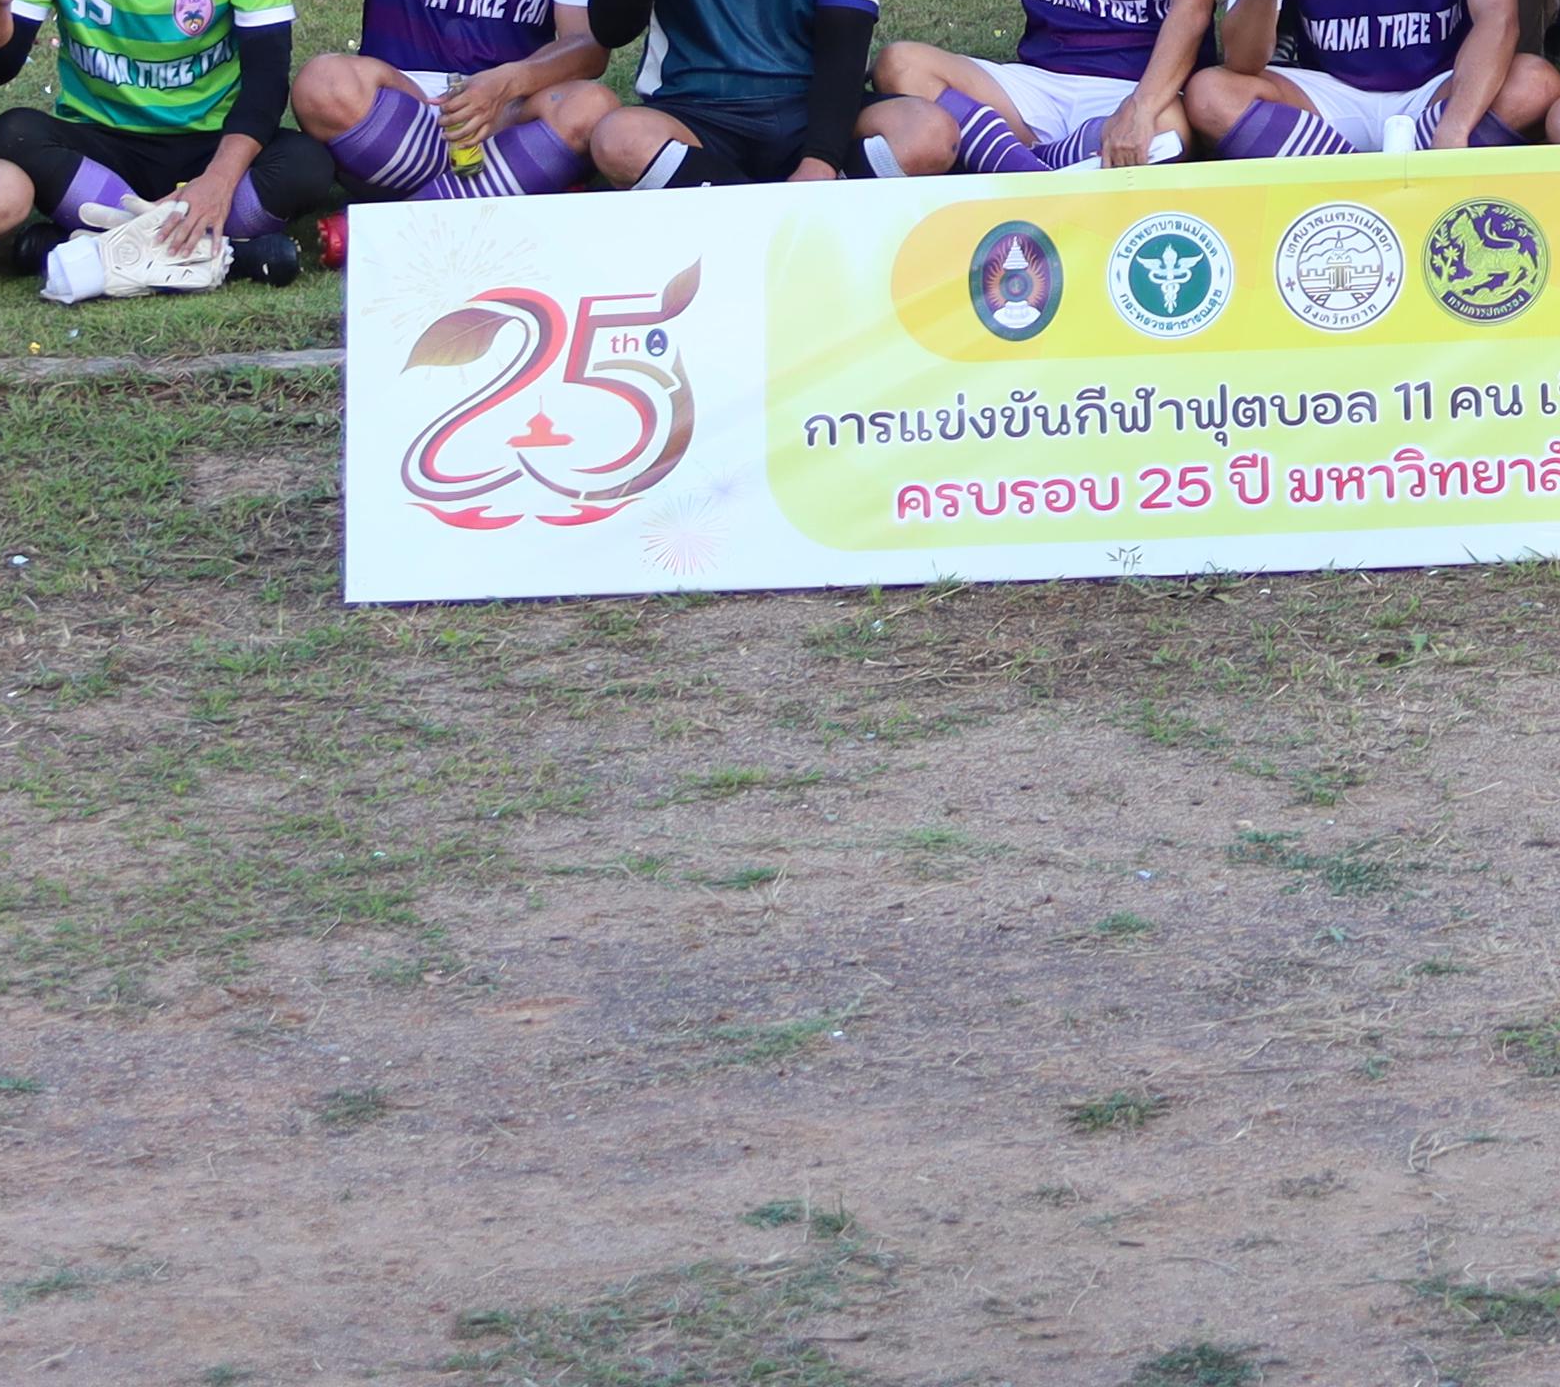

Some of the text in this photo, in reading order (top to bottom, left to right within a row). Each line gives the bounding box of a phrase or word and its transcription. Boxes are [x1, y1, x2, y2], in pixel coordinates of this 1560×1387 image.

[1377, 12, 1433, 49] TREE
[135, 60, 193, 90] TREE
[610, 333, 639, 354] th
[803, 381, 1378, 447] การแข่งขันกีฬาฟุตบอล
[1394, 380, 1433, 422] 11
[1450, 383, 1523, 419] คน
[897, 476, 1121, 519] ครบรอบ
[1139, 465, 1212, 510] 25
[1229, 452, 1270, 505] ปี
